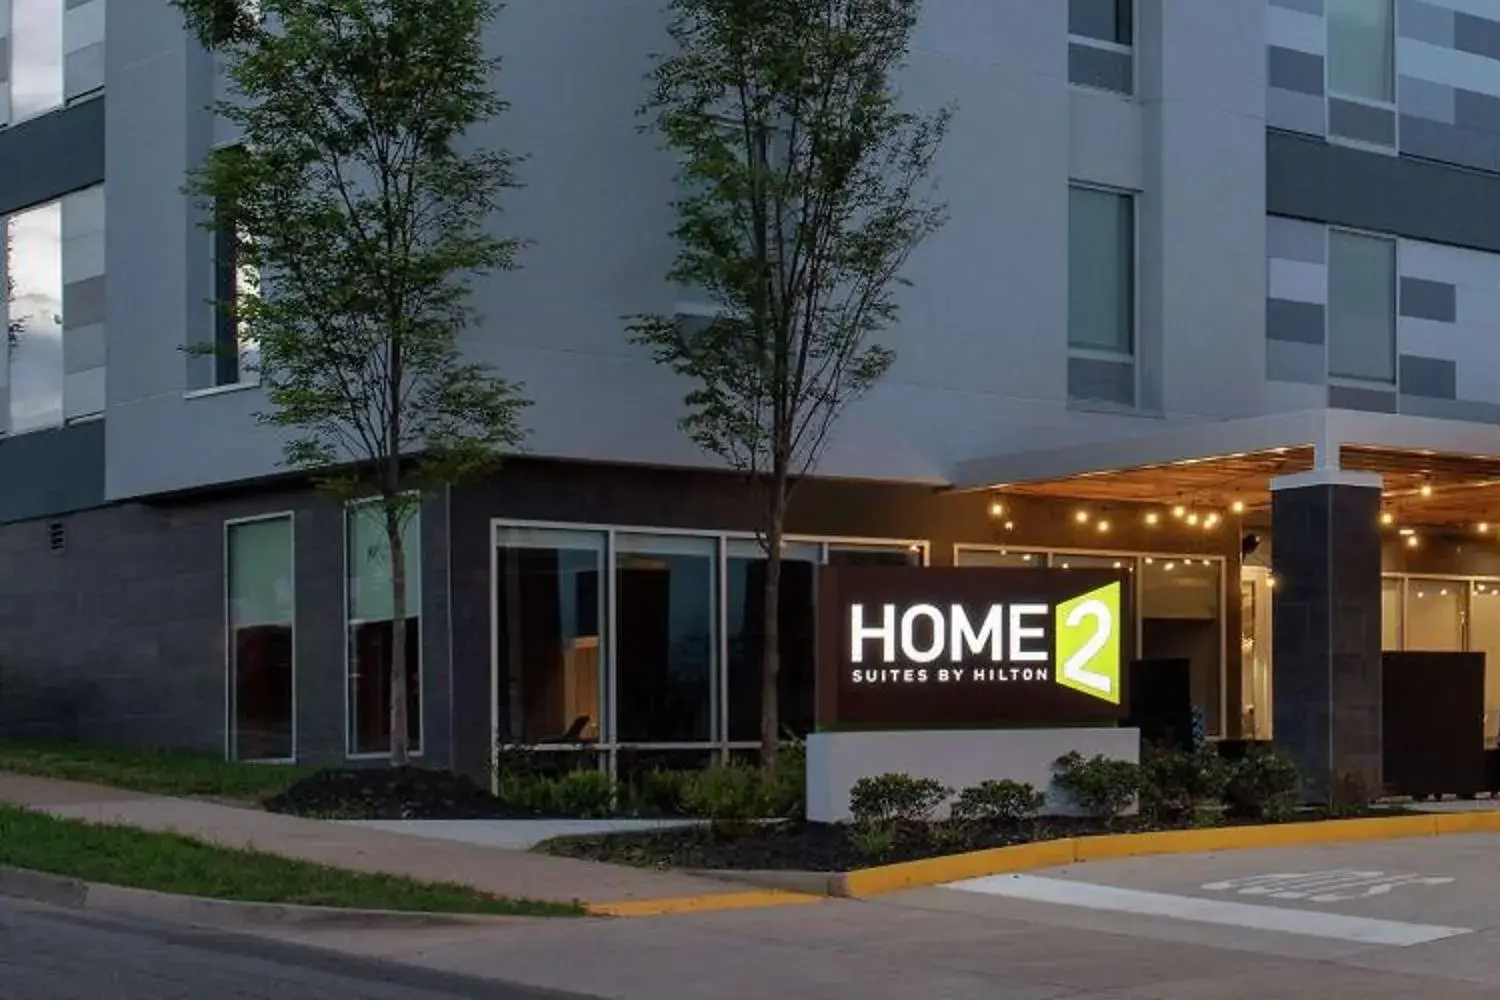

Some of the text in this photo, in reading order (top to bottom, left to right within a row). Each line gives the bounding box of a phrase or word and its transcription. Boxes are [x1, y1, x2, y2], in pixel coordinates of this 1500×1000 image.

[850, 598, 1113, 693] HOME 2
[851, 667, 1048, 683] SUITES BY HILTON
